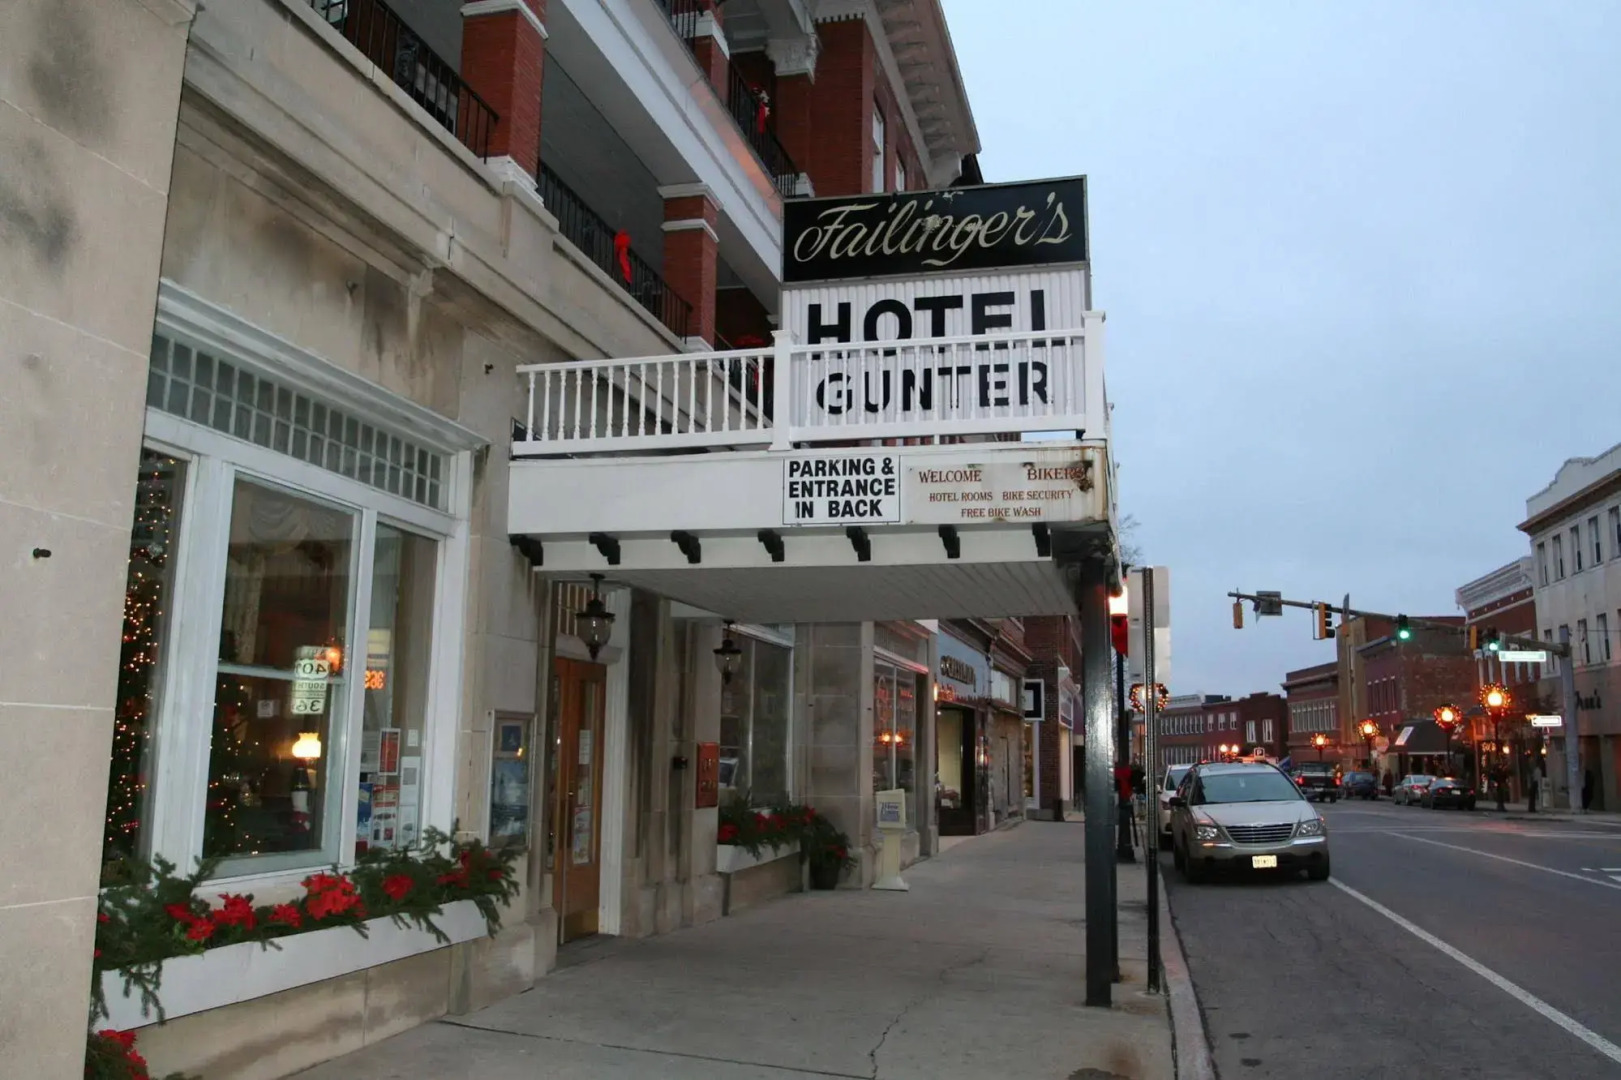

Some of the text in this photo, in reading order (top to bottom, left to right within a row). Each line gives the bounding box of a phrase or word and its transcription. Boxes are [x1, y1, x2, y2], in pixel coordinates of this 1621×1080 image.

[794, 191, 1073, 266] Failinger's
[808, 289, 1073, 360] HOTEL
[816, 361, 1054, 415] GUNTER
[789, 457, 895, 478] PARKING &
[918, 469, 983, 483] WELCOME
[789, 478, 895, 498] ENTRANCE
[929, 489, 1074, 502] HOTEL ROOMS BIKE SECURITY
[795, 499, 883, 518] IN BACK
[961, 506, 1041, 518] FREE BIKE WASH
